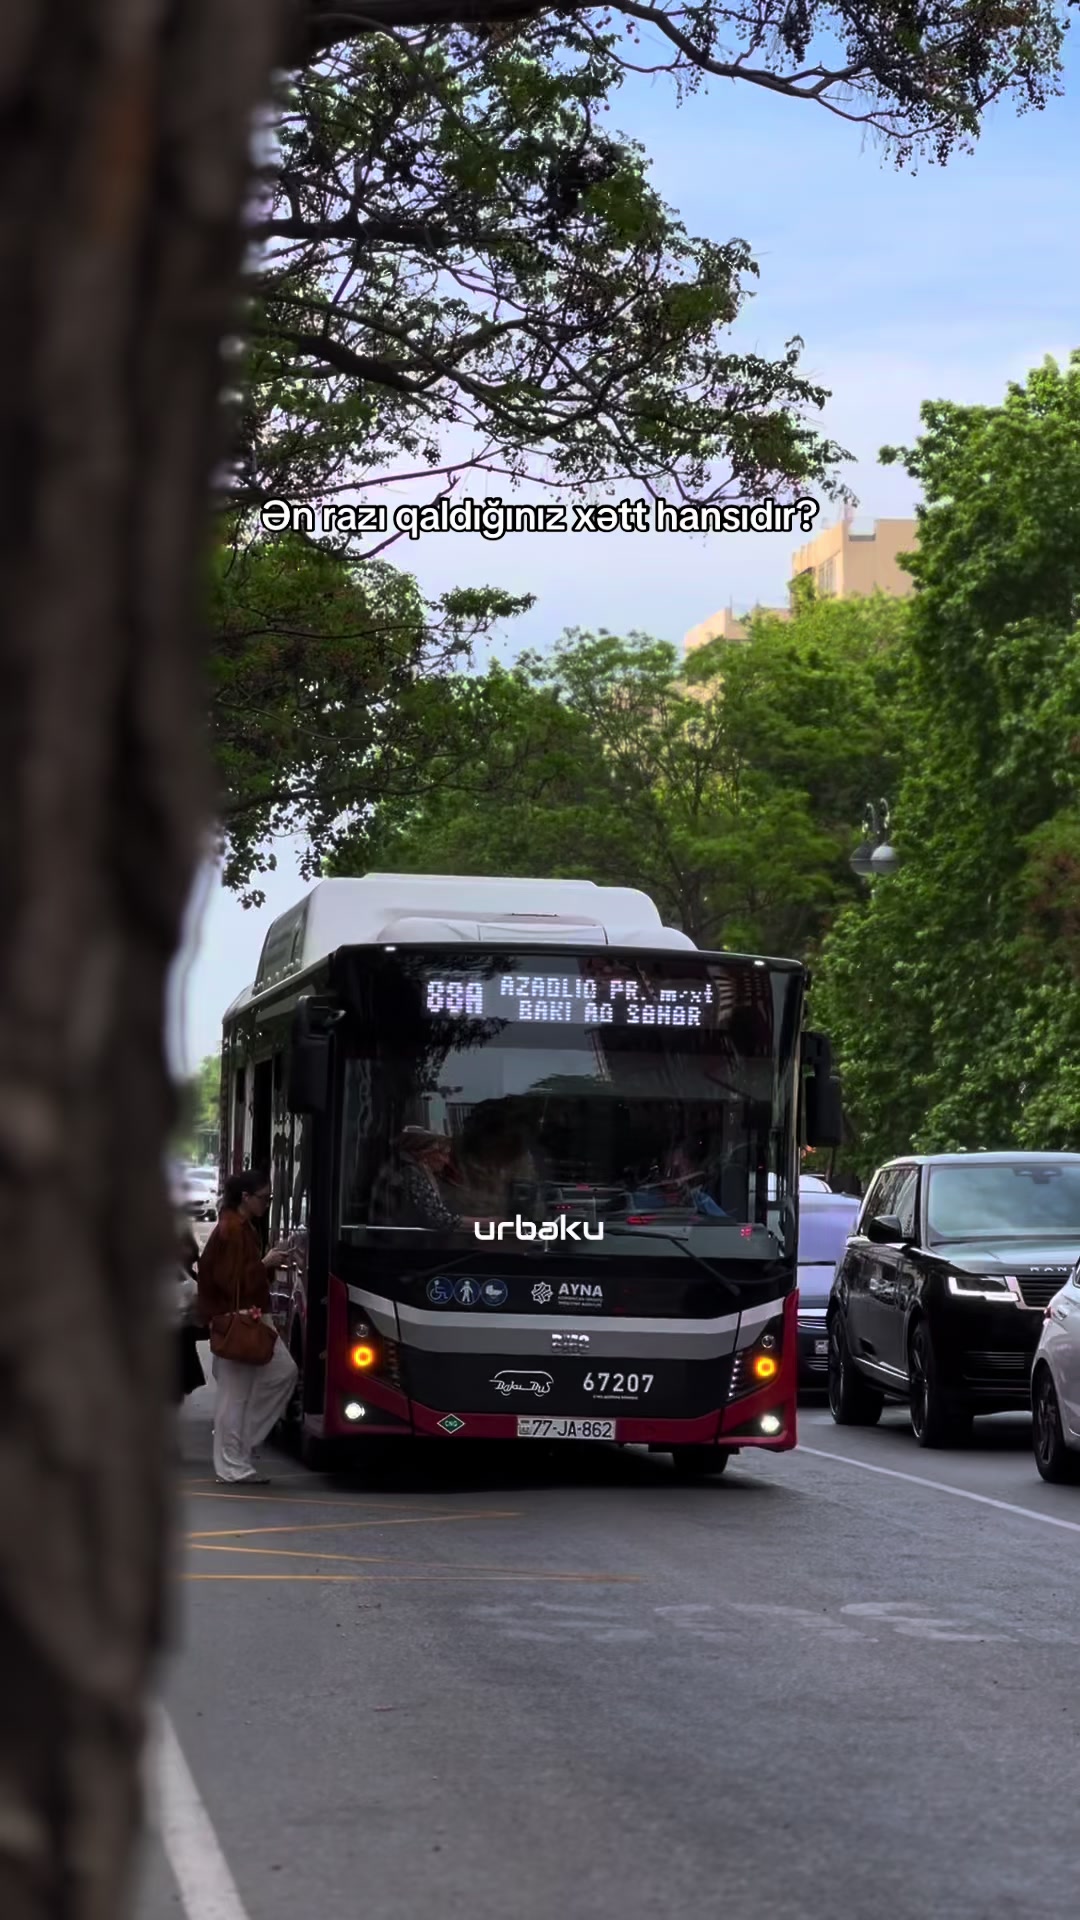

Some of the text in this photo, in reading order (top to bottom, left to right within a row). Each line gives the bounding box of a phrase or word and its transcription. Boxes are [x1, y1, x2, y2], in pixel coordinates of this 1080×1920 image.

[500, 976, 597, 999] AZADLIQ
[610, 980, 646, 1000] PR.
[519, 1000, 571, 1021] BAKI
[558, 1283, 603, 1297] AYNA
[583, 1372, 654, 1393] 67207
[532, 1419, 612, 1438] 77-JA-862
